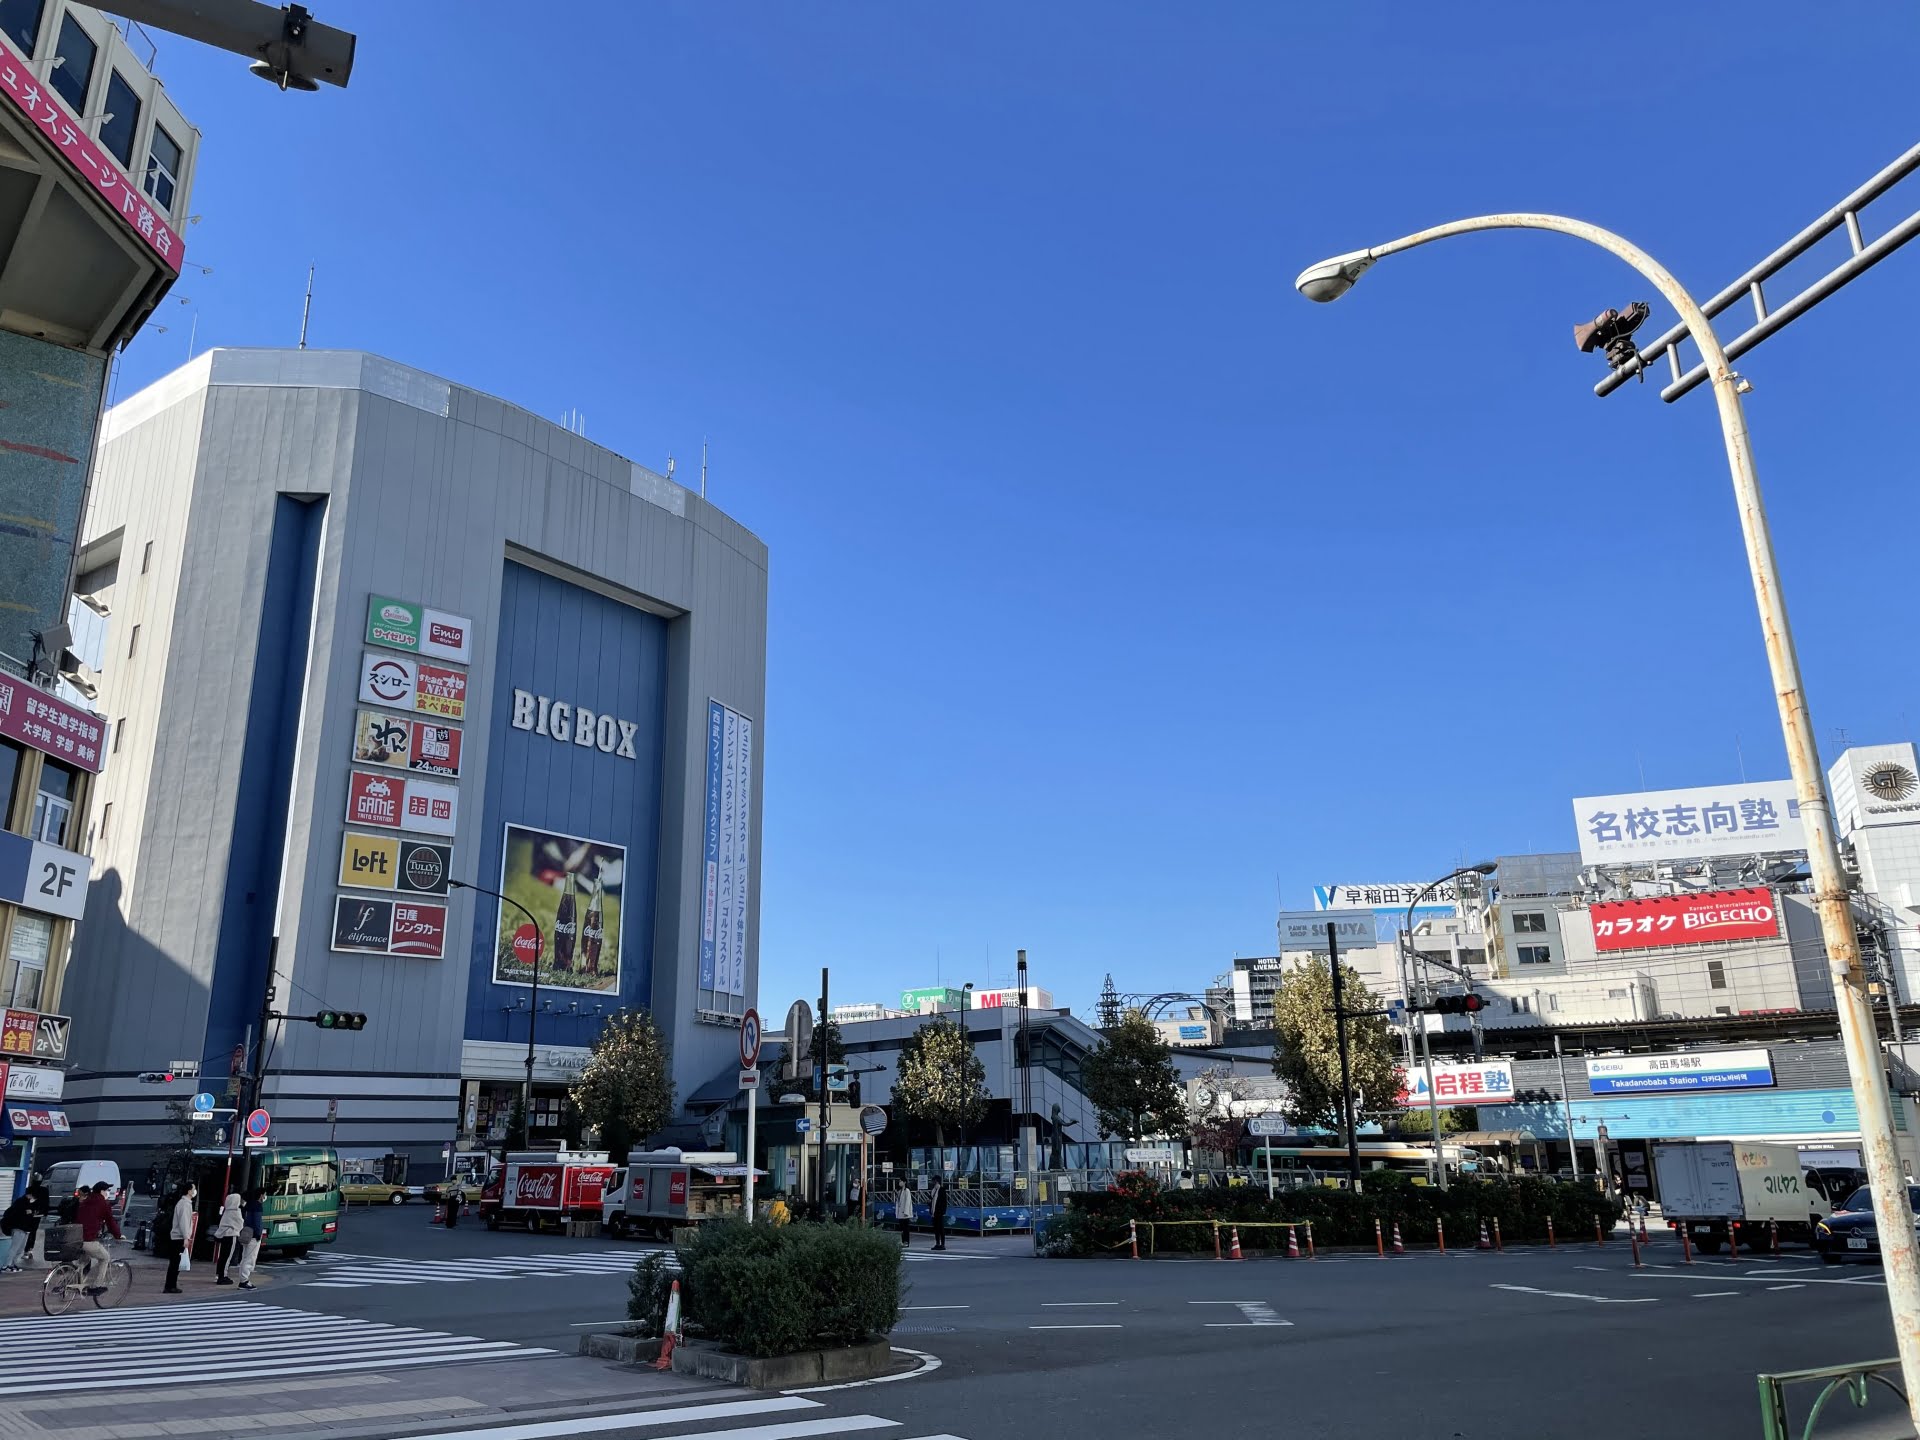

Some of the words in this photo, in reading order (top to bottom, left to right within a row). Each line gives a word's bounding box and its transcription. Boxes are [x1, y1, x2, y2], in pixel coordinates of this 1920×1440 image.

[0, 48, 172, 256] ュオステージ下落合
[373, 628, 417, 645] サイゼリヤ
[432, 625, 461, 640] Emio
[368, 673, 411, 688] スシロー
[425, 684, 458, 699] NEXT
[416, 699, 462, 717] 食べ放題
[26, 697, 99, 743] 留学生進学指導
[22, 720, 52, 744] 大学院
[55, 734, 75, 753] 学部
[77, 744, 96, 763] 美術
[357, 796, 395, 816] GAME
[373, 814, 394, 823] STATION
[1587, 798, 1780, 843] 名校志向塾
[40, 862, 76, 898] 2F
[1345, 886, 1456, 905] 早稲田予備校
[1716, 900, 1761, 909] Entertainment
[396, 908, 418, 921] 日産
[1682, 912, 1717, 929] BIG
[1721, 905, 1773, 922] ECHO
[395, 922, 441, 935] レンタカー
[1311, 921, 1368, 937] SUUYA
[1596, 914, 1677, 936] カラオケ
[340, 930, 388, 943] élifrance
[5, 1017, 34, 1031] 3年連続
[3, 1030, 33, 1052] 金賞
[36, 1038, 48, 1052] 2F
[1647, 1057, 1702, 1071] 高田馬場駅
[1610, 1078, 1668, 1088] Takadanobaba
[1669, 1076, 1698, 1085] Station
[29, 1115, 51, 1126] 宝くじ
[1764, 1174, 1800, 1194] マルヤス
